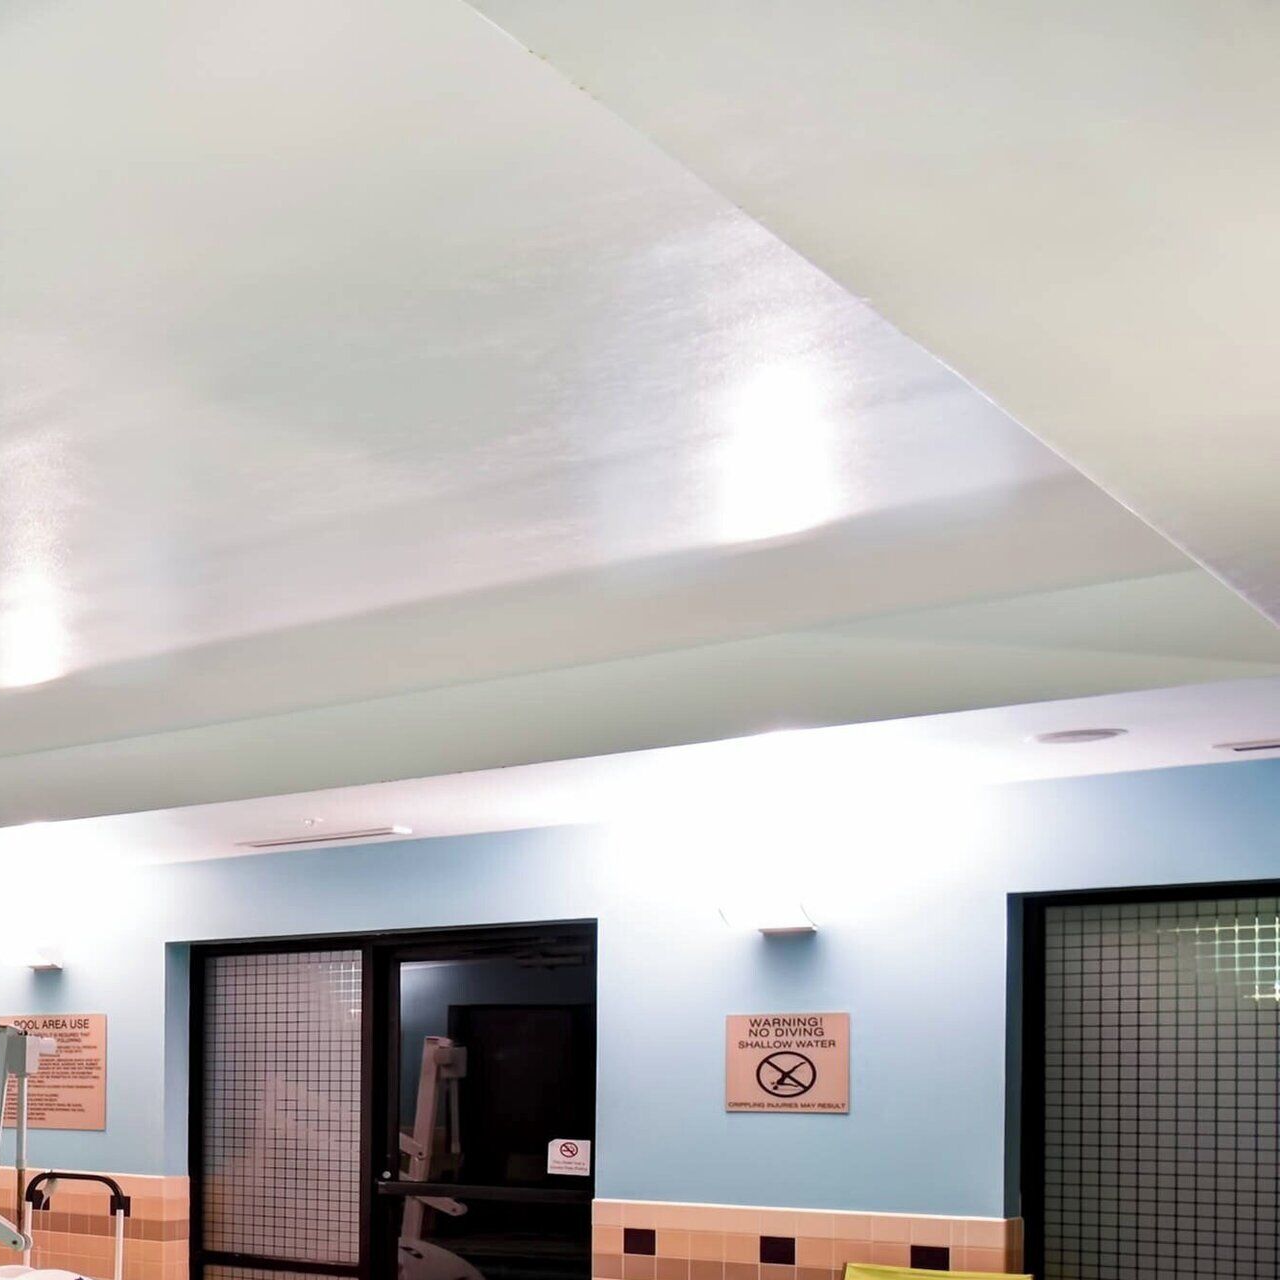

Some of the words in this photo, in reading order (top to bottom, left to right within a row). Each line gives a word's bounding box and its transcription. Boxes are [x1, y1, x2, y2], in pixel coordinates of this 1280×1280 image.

[42, 1020, 67, 1029] AREA
[70, 1019, 89, 1028] USE
[749, 1017, 822, 1027] WARNING!
[749, 1028, 770, 1037] NO
[775, 1027, 824, 1037] DIVING
[738, 1040, 793, 1049] SHALLOW
[796, 1040, 836, 1048] WATER
